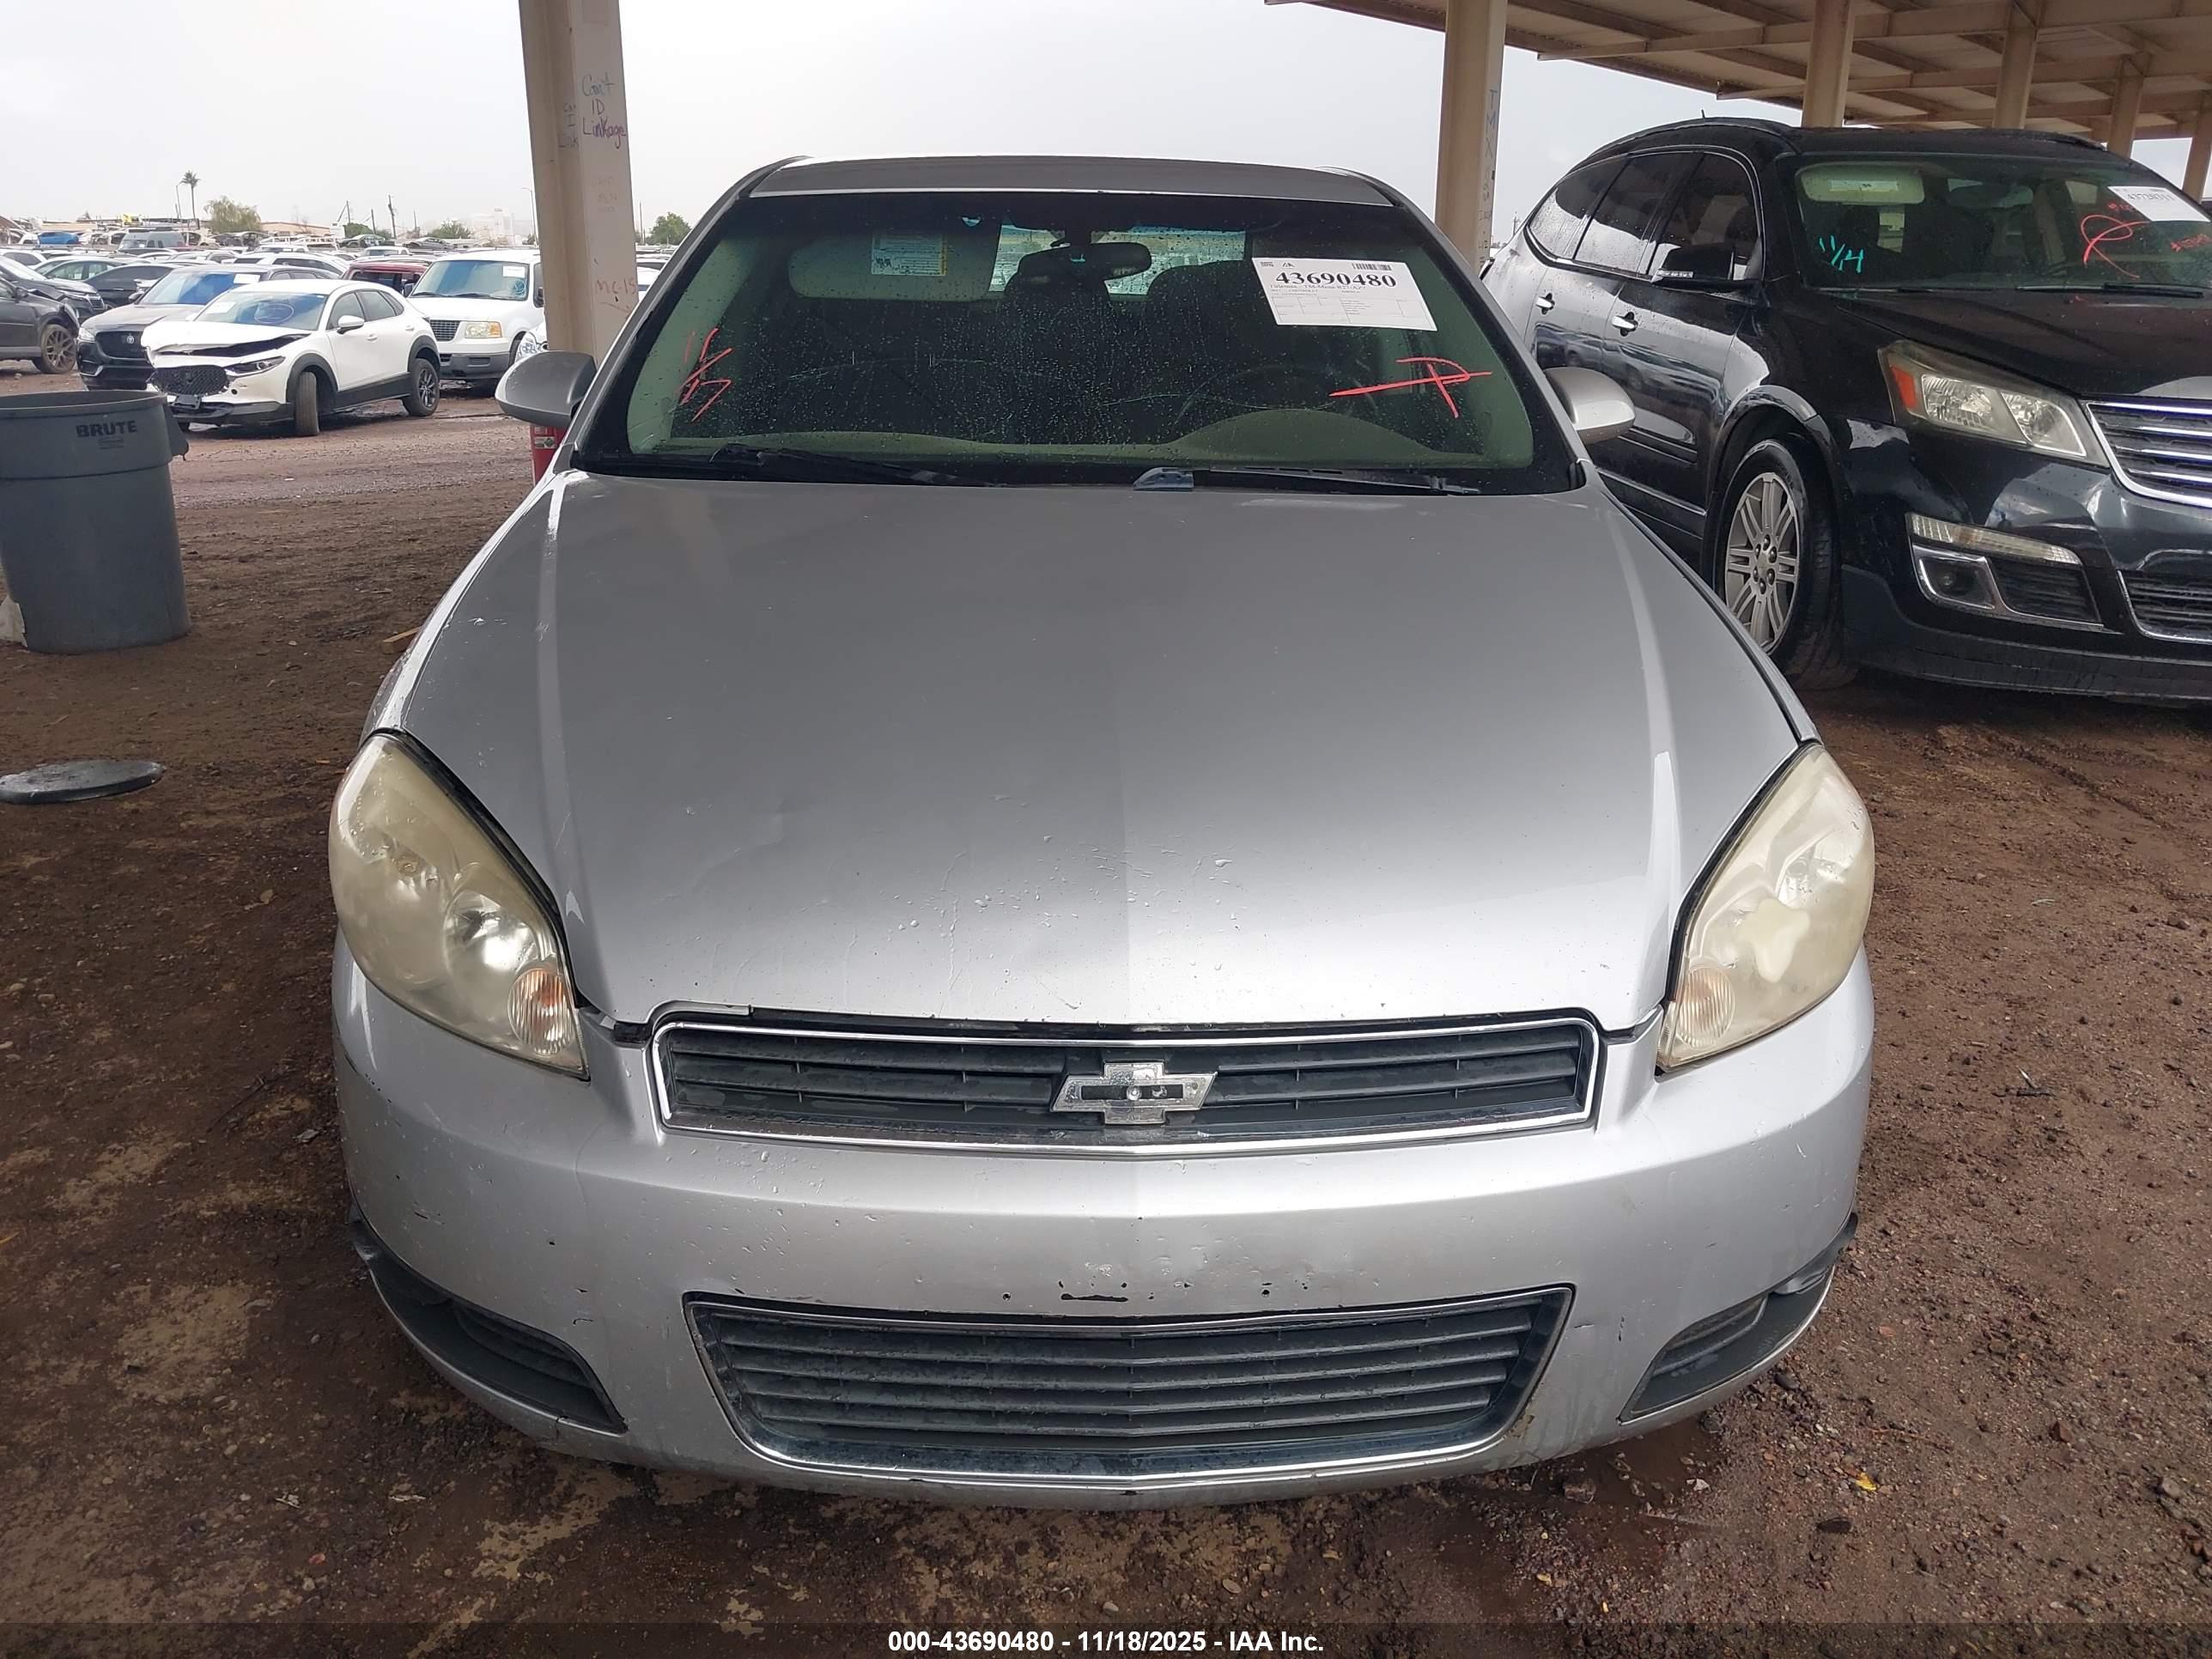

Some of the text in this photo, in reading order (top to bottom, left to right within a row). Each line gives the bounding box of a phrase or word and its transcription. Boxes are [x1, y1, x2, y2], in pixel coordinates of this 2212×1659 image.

[591, 98, 605, 116] ID
[1275, 271, 1397, 289] 43690480
[76, 420, 137, 438] BRUTE
